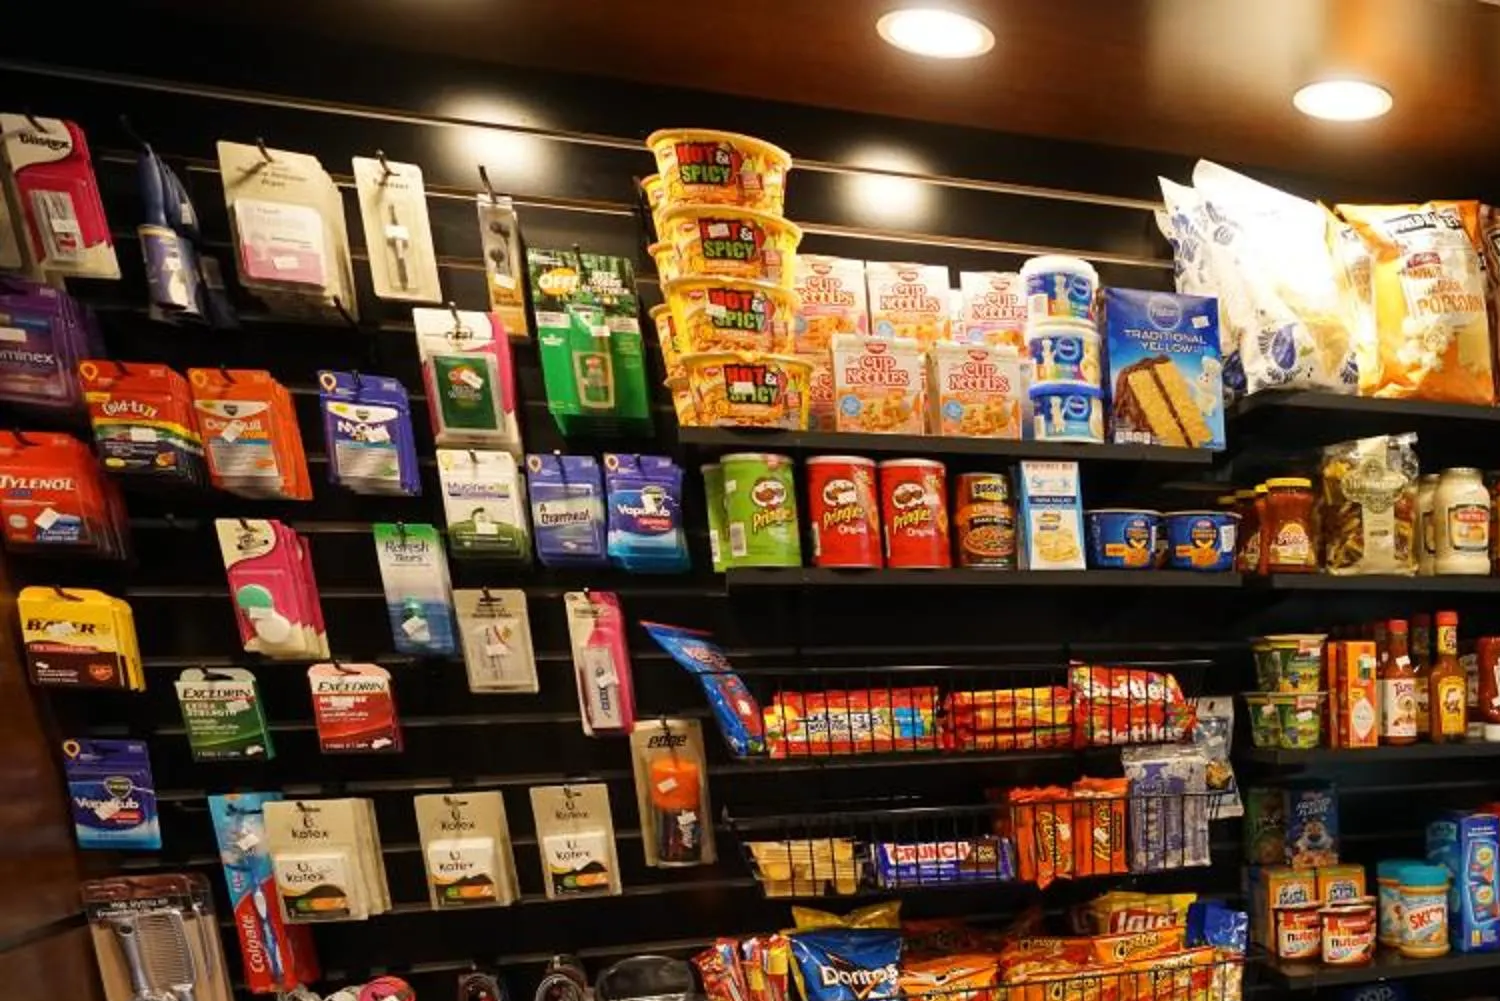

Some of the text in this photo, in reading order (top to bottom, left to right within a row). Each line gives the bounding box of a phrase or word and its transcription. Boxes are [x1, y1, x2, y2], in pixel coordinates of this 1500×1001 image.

[680, 164, 731, 183] SPICY
[703, 239, 756, 259] SPICY
[1122, 327, 1209, 346] TRADITIONAL
[1139, 341, 1194, 354] YELLOW
[845, 367, 911, 386] NOODLES
[888, 843, 970, 863] CRUNCH
